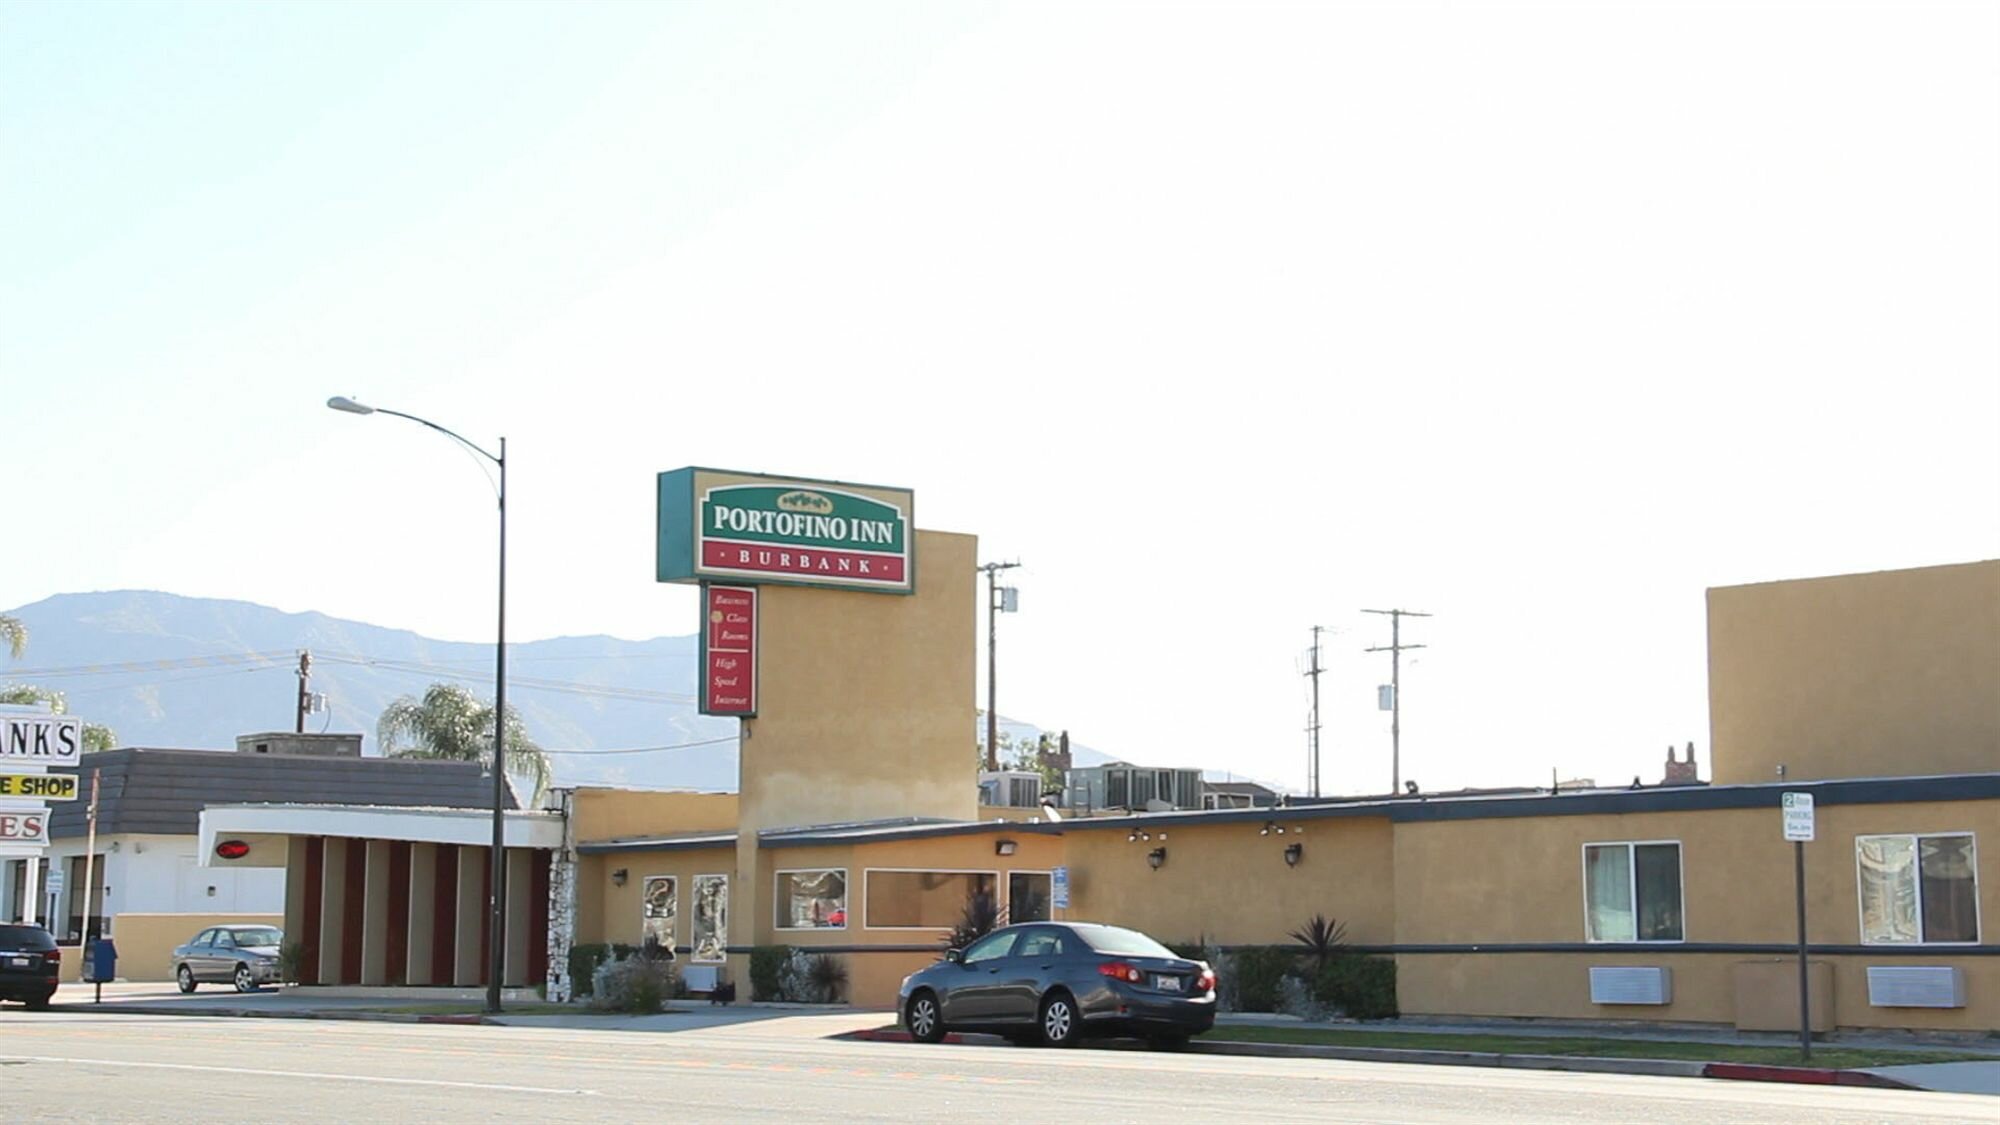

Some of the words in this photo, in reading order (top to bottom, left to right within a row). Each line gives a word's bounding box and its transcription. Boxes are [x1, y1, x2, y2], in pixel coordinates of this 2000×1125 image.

[714, 506, 847, 540] PORTOFINO
[850, 518, 894, 544] INN
[739, 549, 870, 573] BURBANK
[726, 613, 748, 623] Class
[721, 630, 749, 640] Rooms
[715, 657, 737, 670] High
[714, 675, 738, 688] Speed
[714, 693, 748, 705] Internet
[0, 721, 75, 756] NK'S
[20, 777, 75, 796] SHOP
